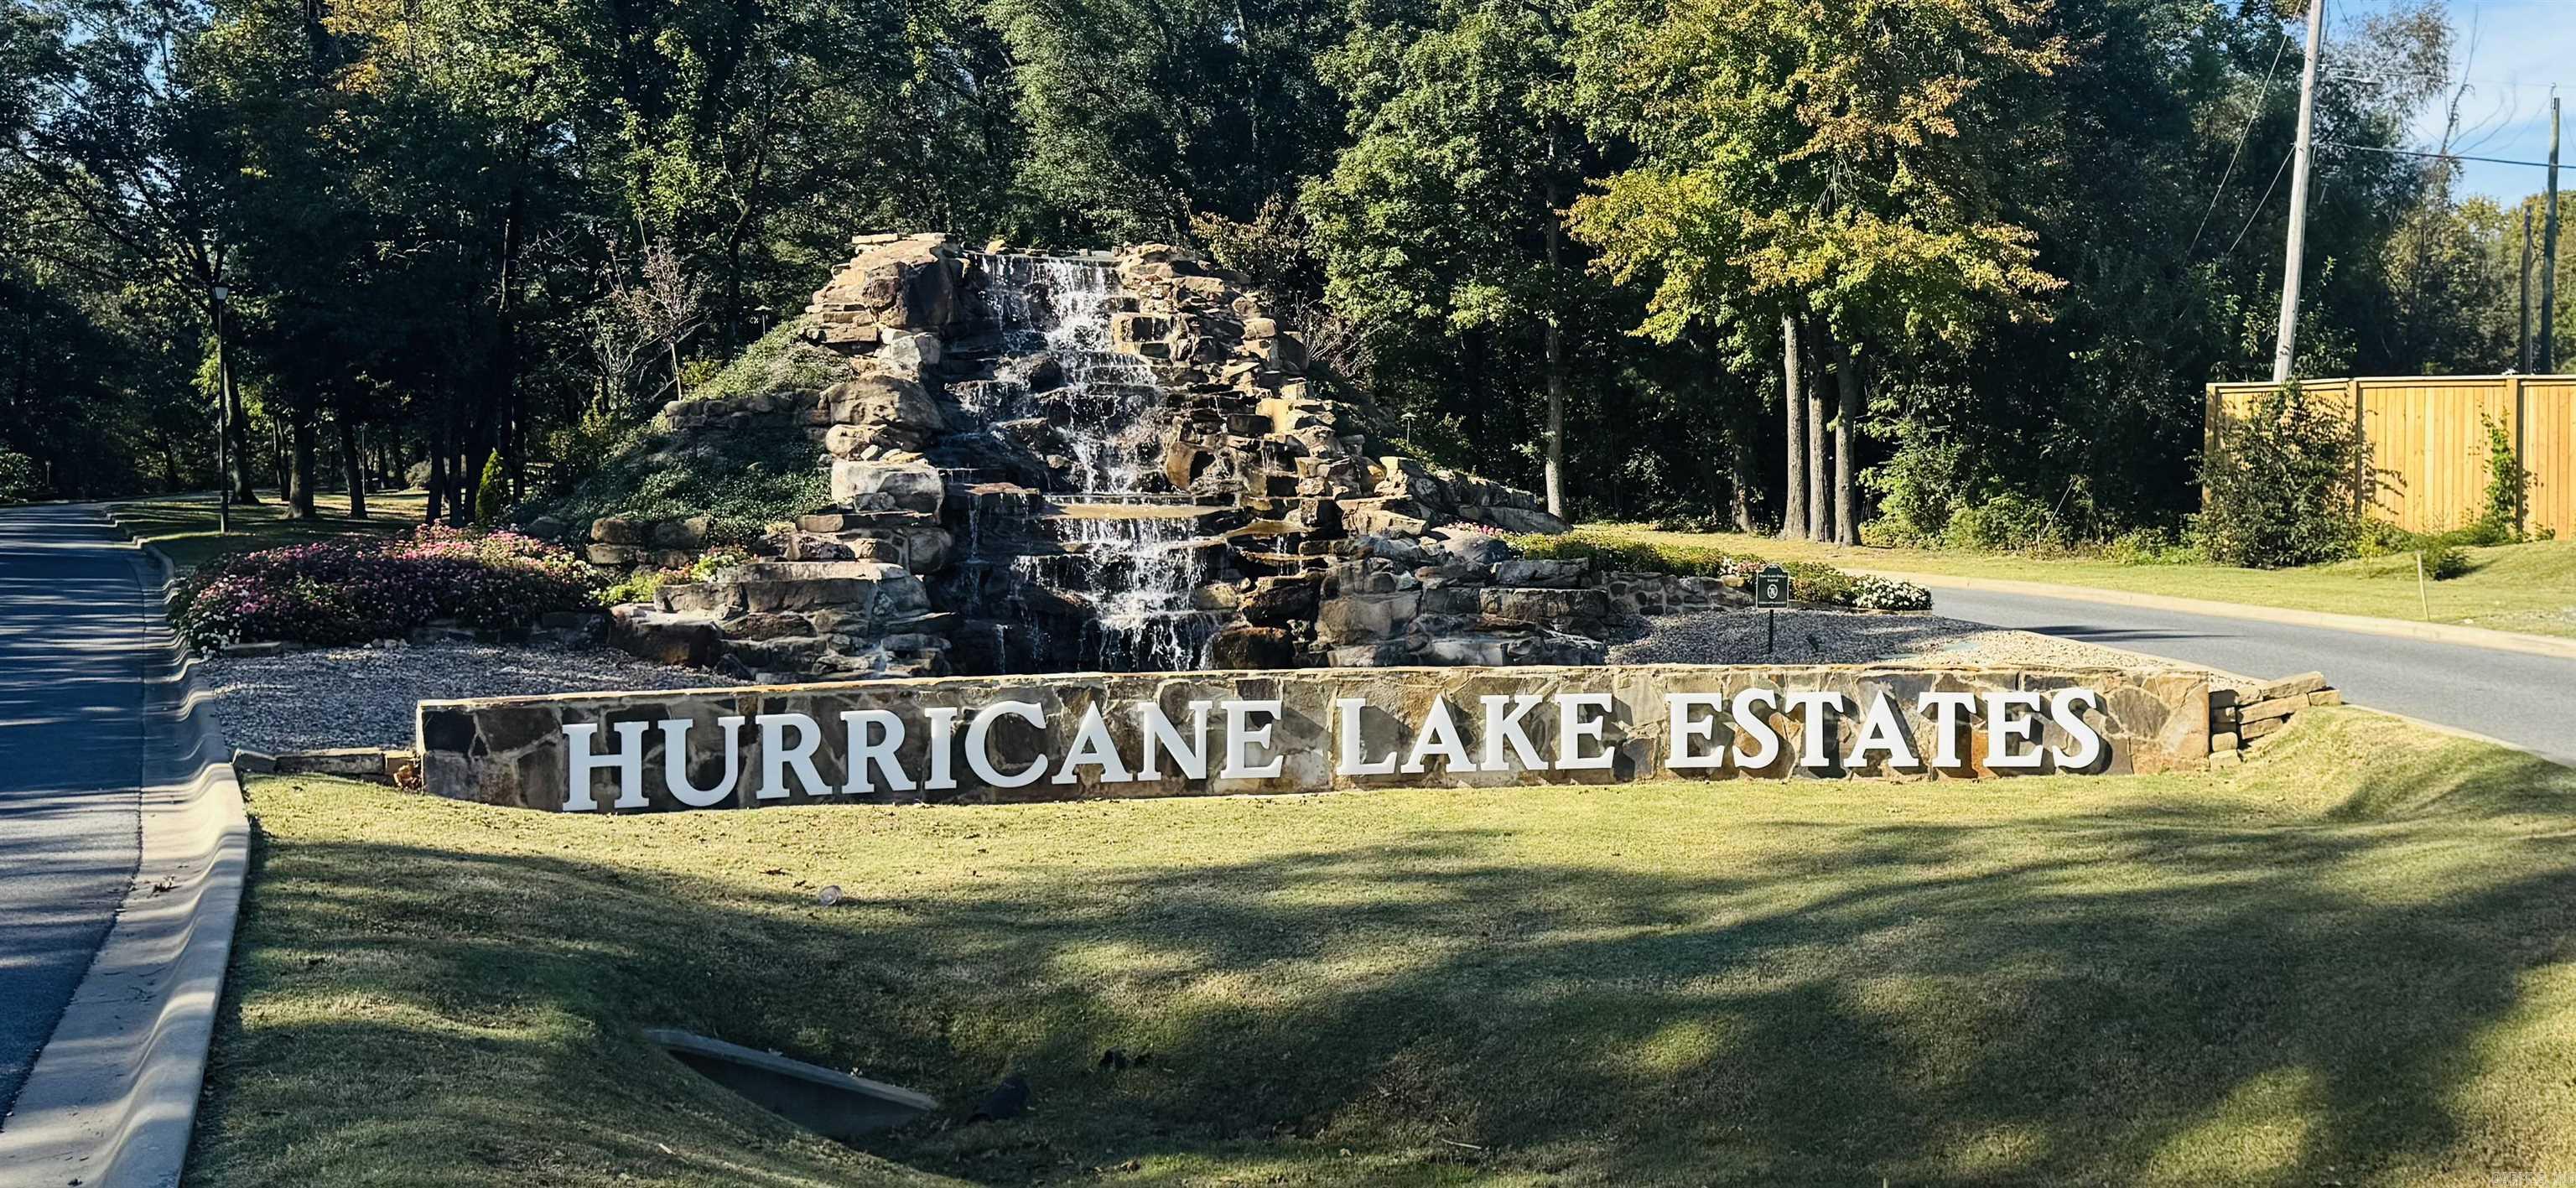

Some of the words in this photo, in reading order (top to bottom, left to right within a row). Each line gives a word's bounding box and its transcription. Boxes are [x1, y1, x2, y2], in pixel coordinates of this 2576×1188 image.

[562, 700, 1284, 812] HURRICANE
[1337, 693, 1617, 776] LAKE
[1666, 688, 2098, 770] ESTATES
